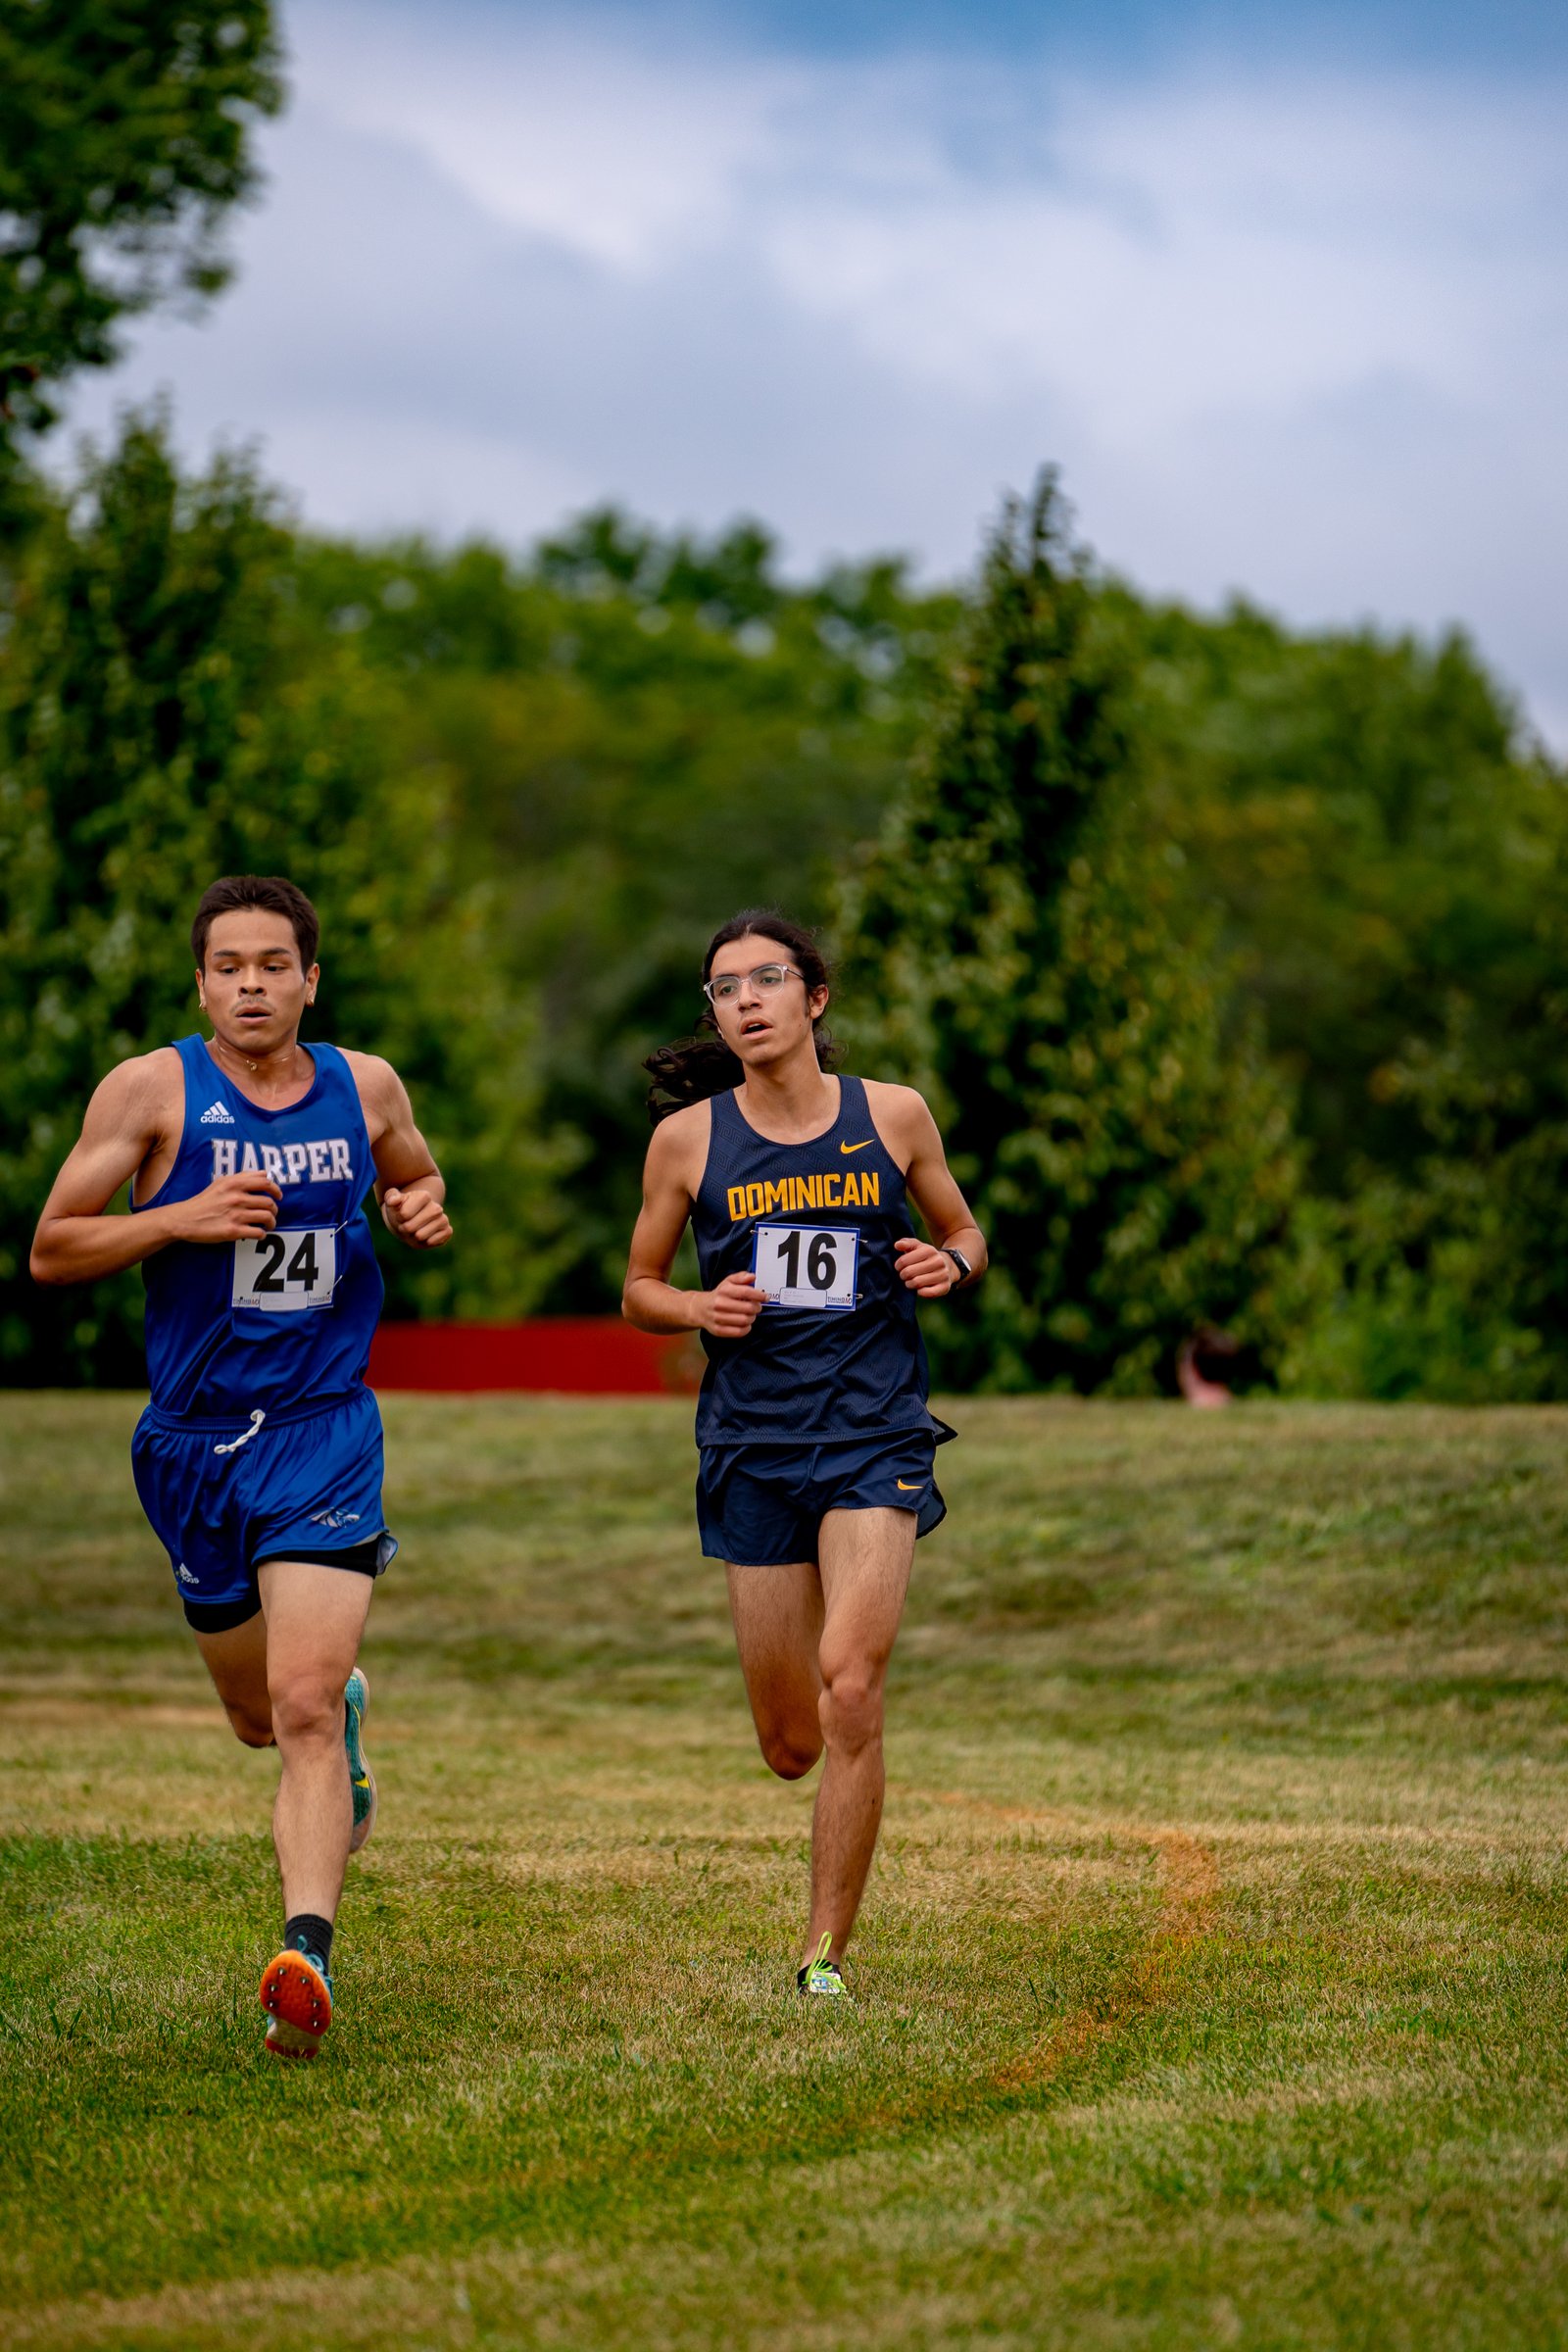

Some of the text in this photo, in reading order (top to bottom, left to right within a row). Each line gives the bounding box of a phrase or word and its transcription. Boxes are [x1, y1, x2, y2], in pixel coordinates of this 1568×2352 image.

[200, 1113, 235, 1124] adidas
[211, 1138, 354, 1185] HARPER
[727, 1172, 880, 1222] DOMINICAN
[252, 1233, 318, 1293] 24
[777, 1230, 838, 1291] 16
